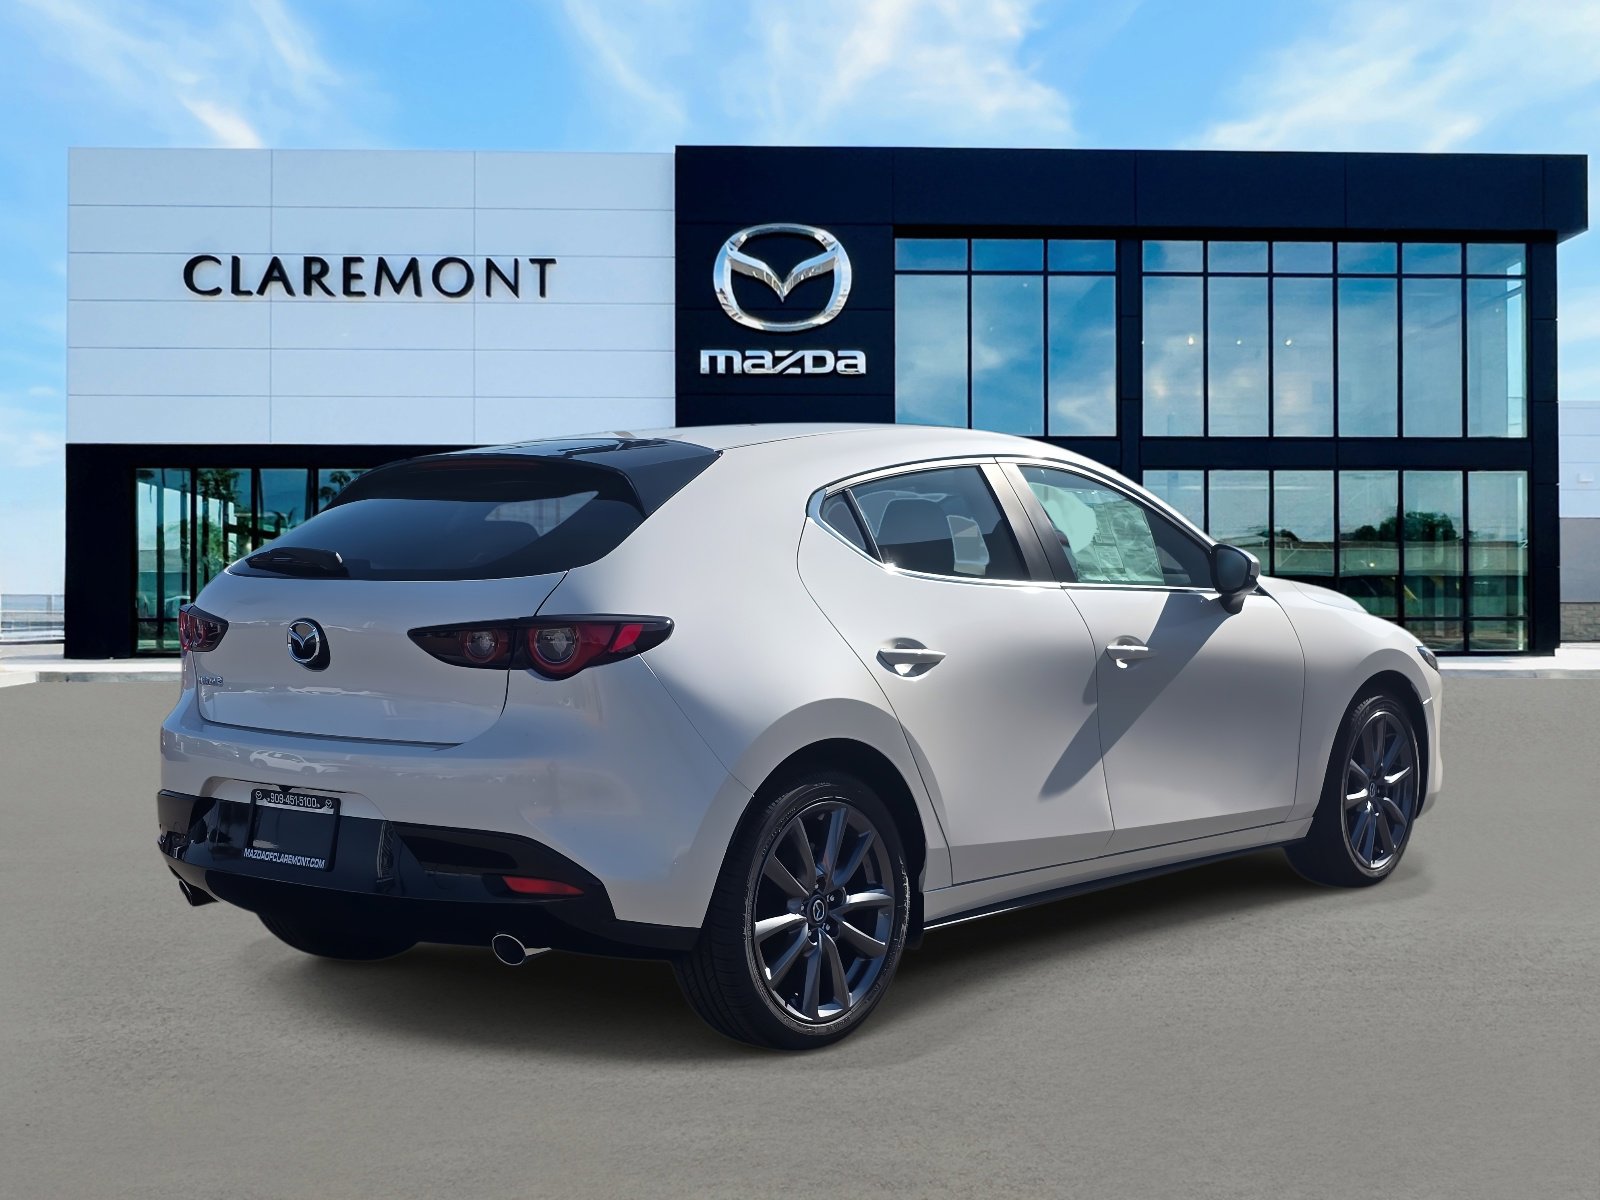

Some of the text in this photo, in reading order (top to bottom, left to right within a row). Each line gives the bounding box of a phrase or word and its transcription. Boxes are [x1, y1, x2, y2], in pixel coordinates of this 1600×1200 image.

[183, 255, 556, 297] CLAREMONT
[270, 792, 317, 808] 909-451-5100
[243, 848, 326, 868] MAZDAOFCLAREMONT.COM
